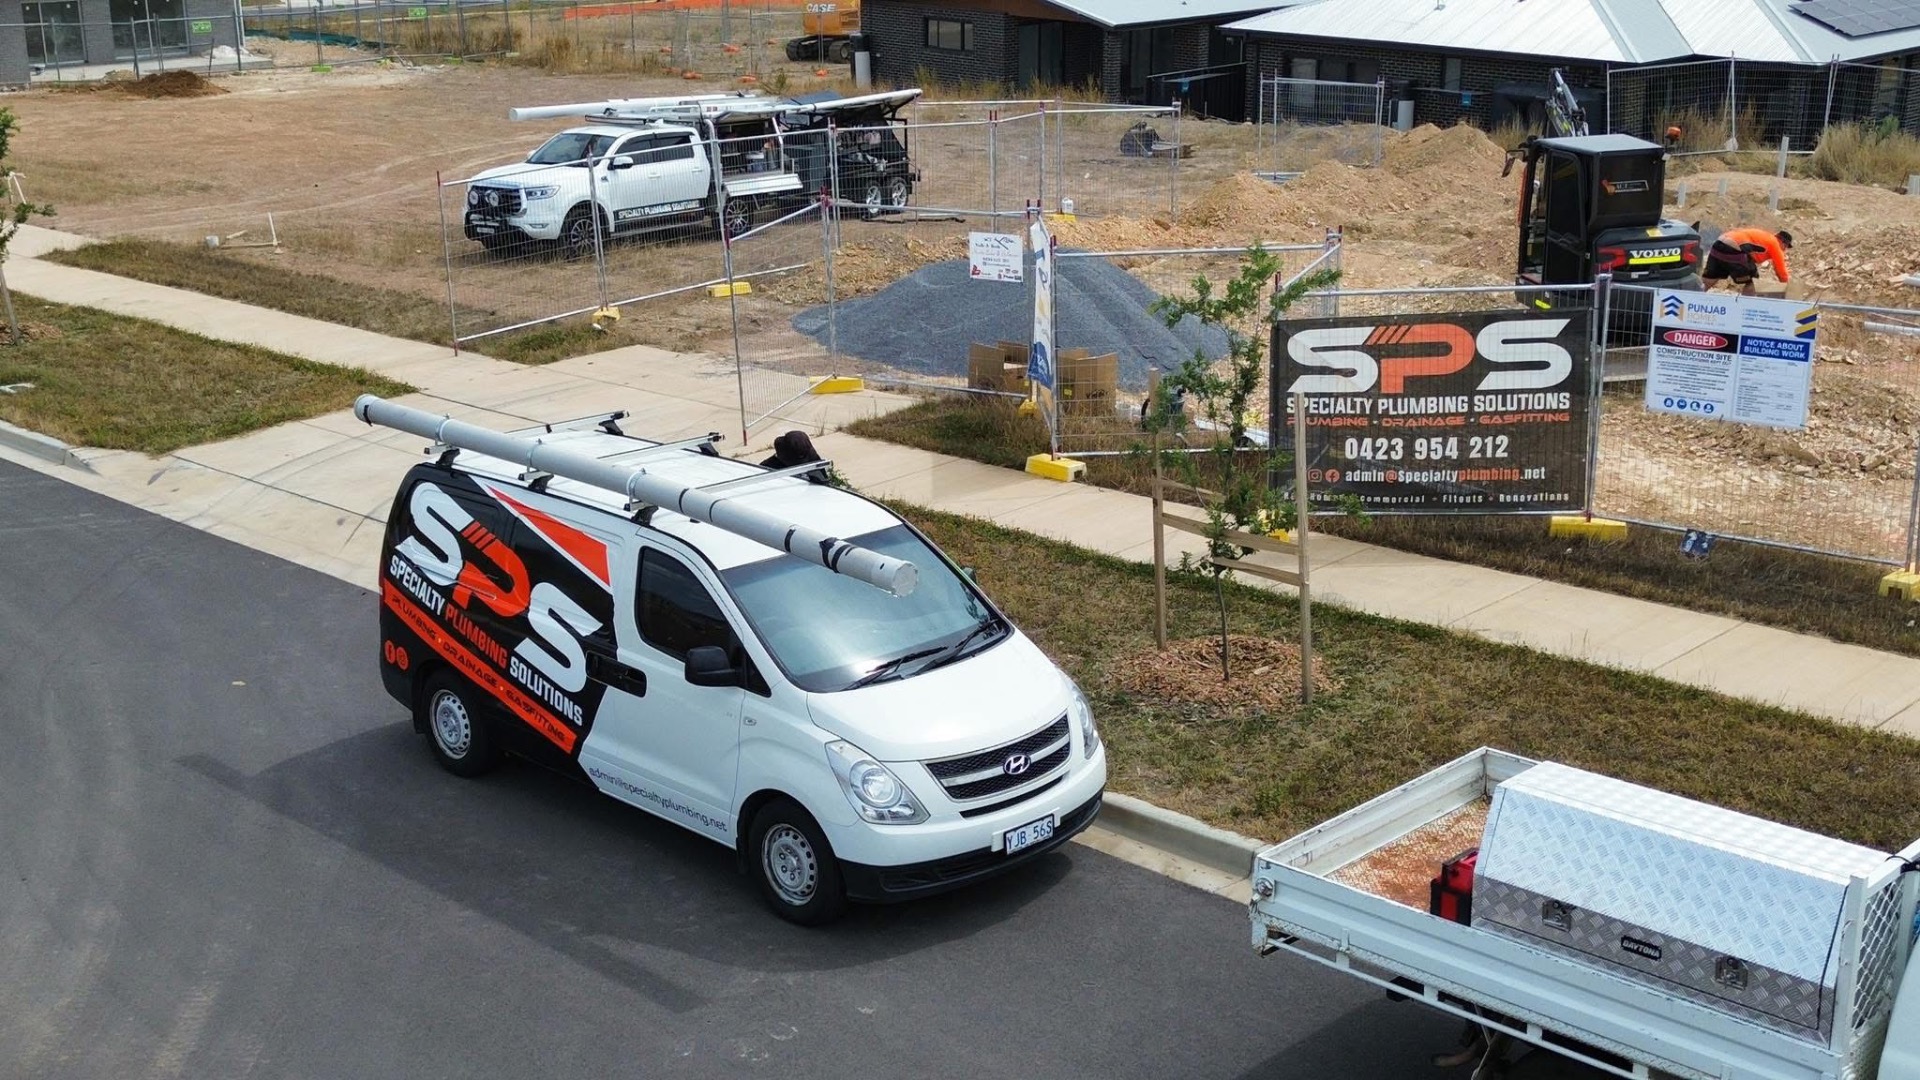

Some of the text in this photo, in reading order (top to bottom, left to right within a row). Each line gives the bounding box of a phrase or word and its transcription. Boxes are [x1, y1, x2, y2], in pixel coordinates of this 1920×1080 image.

[806, 3, 836, 13] CASE
[1629, 247, 1681, 258] VOLVO
[1687, 303, 1727, 316] PUNJAB
[1674, 333, 1717, 347] DANGER
[1747, 339, 1805, 352] NOTICE ABOUT
[1286, 318, 1573, 394] SPS
[1656, 347, 1714, 360] CONSTRUCTION
[1715, 353, 1732, 362] SITE
[1744, 346, 1806, 359] BUILDING WORK
[1378, 395, 1468, 415] PLUMBING
[1474, 393, 1570, 412] SOLUTIONS
[1287, 412, 1570, 428] PUMBING DRAINAGE GASFITTING
[1345, 435, 1509, 460] 0423 954 212
[1499, 492, 1569, 503] Renovations
[395, 482, 603, 693] SPS
[390, 555, 584, 727] SPECIALTY PLUMBING SOLUTIONS
[391, 594, 566, 742] PLUMBING DRAINAGE GASFITTING
[1007, 831, 1027, 850] YJB
[1033, 820, 1052, 840] 56S
[1622, 940, 1660, 957] DAYTONA
